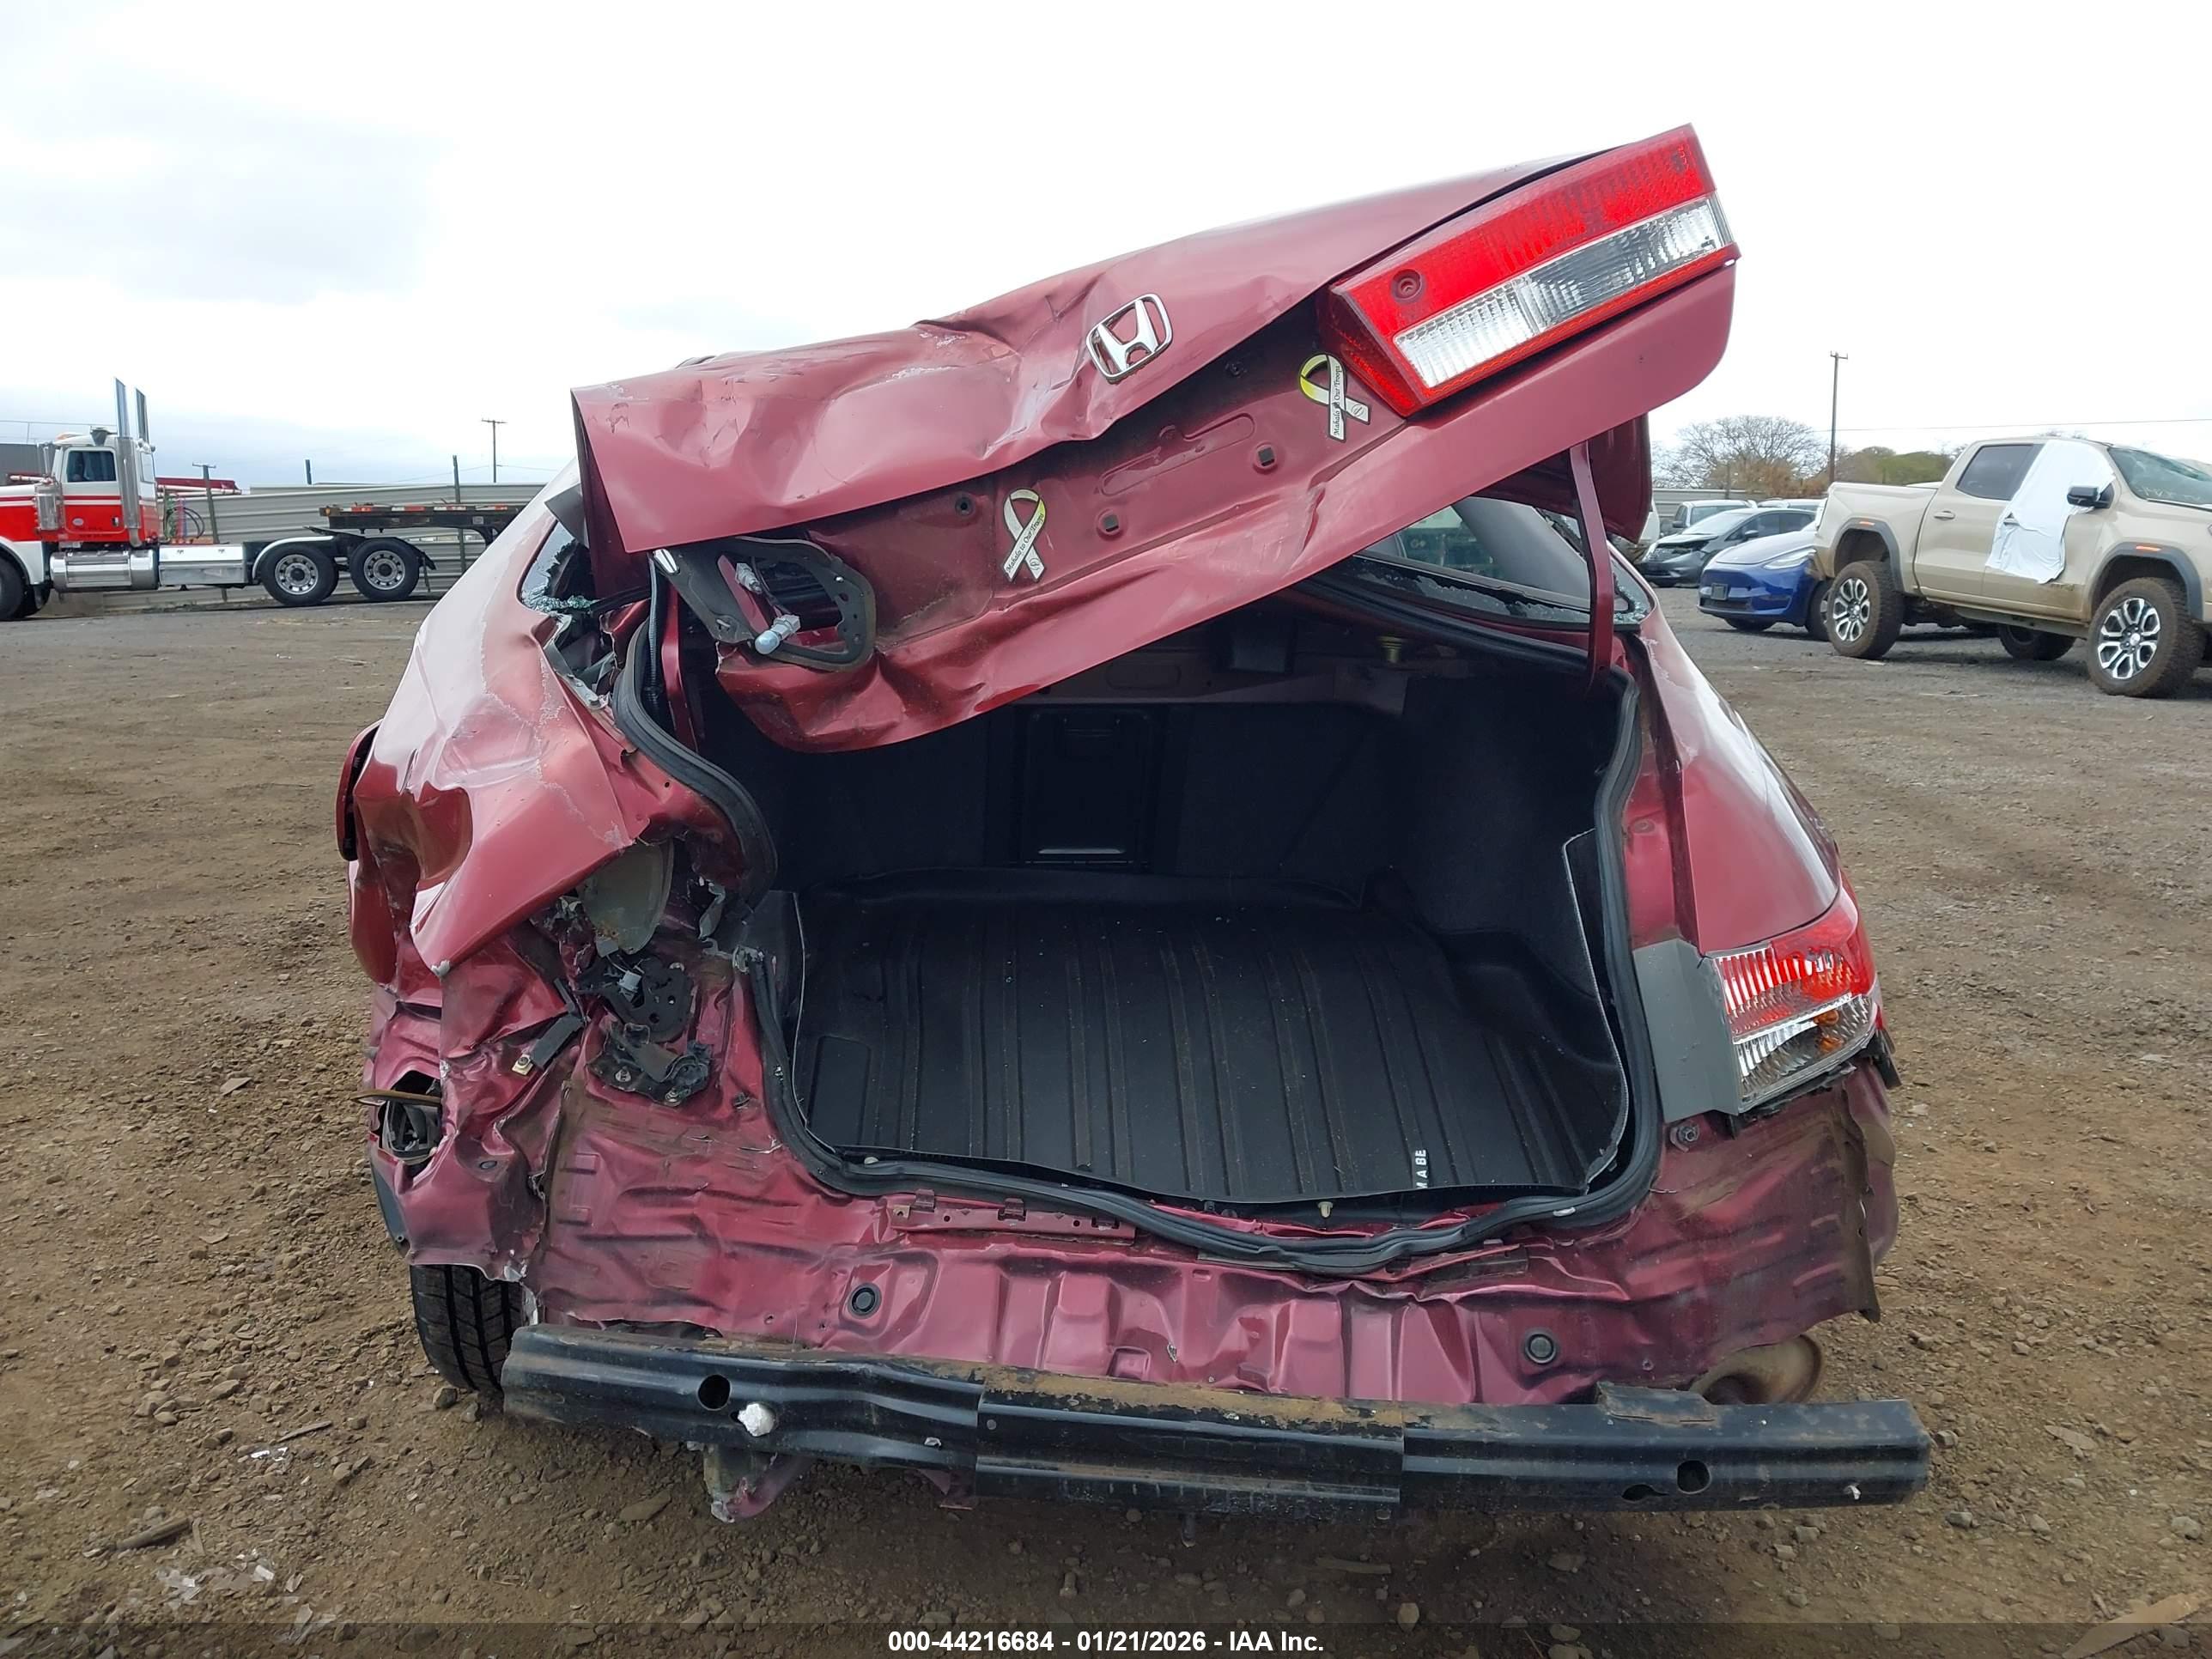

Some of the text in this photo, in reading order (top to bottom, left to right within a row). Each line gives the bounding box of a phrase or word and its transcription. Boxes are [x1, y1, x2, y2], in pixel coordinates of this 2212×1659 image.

[1334, 365, 1343, 386] Troops
[1006, 514, 1044, 573] Mahalo to Our Troops
